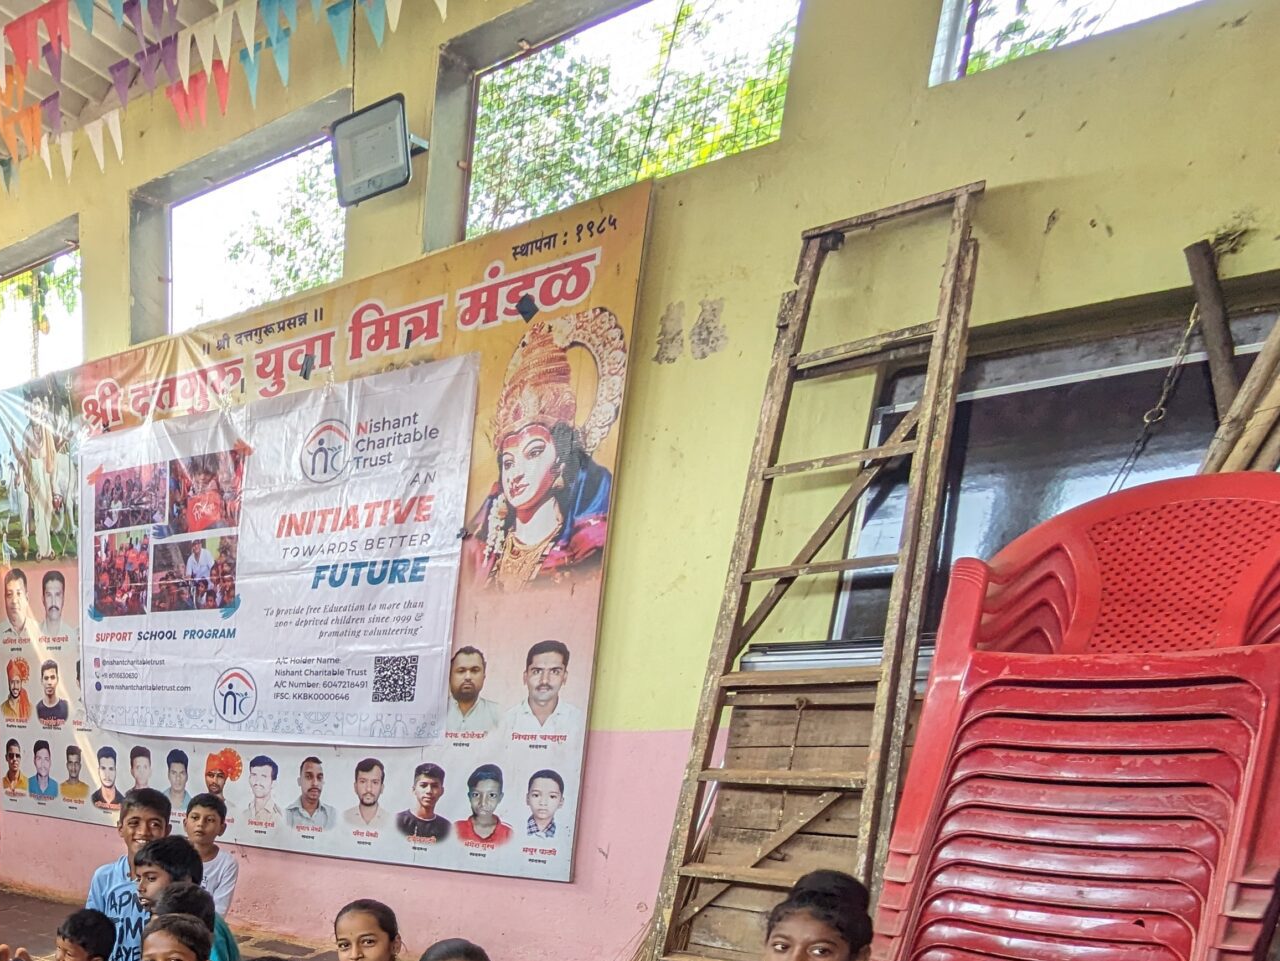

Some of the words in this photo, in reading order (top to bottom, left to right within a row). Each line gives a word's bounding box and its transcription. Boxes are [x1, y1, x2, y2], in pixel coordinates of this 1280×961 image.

[512, 233, 556, 260] स्थापना
[576, 214, 618, 242] १९८५
[255, 331, 335, 397] युवा
[348, 300, 445, 361] मित्र
[458, 253, 598, 328] मंडळ
[356, 411, 418, 436] Nishant
[355, 425, 440, 453] Charitable
[353, 451, 393, 470] Trust
[410, 471, 437, 486] AN
[276, 495, 436, 538] INITIATIVE
[282, 540, 358, 559] TOWARDS
[364, 533, 431, 551] BETTER
[311, 556, 430, 589] FUTURE
[275, 605, 304, 618] provide
[306, 605, 321, 616] free
[323, 602, 365, 614] Education
[367, 602, 376, 611] to
[379, 602, 401, 610] more
[403, 600, 424, 609] than
[295, 616, 328, 628] deprived
[330, 614, 365, 625] children
[368, 613, 390, 624] since
[95, 632, 133, 643] SUPPORT
[137, 630, 177, 641] SCHOOL
[183, 628, 236, 640] PROGRAM
[318, 627, 361, 639] promoting
[346, 668, 367, 676] Trust
[274, 681, 287, 689] A/C
[107, 890, 143, 915] APN
